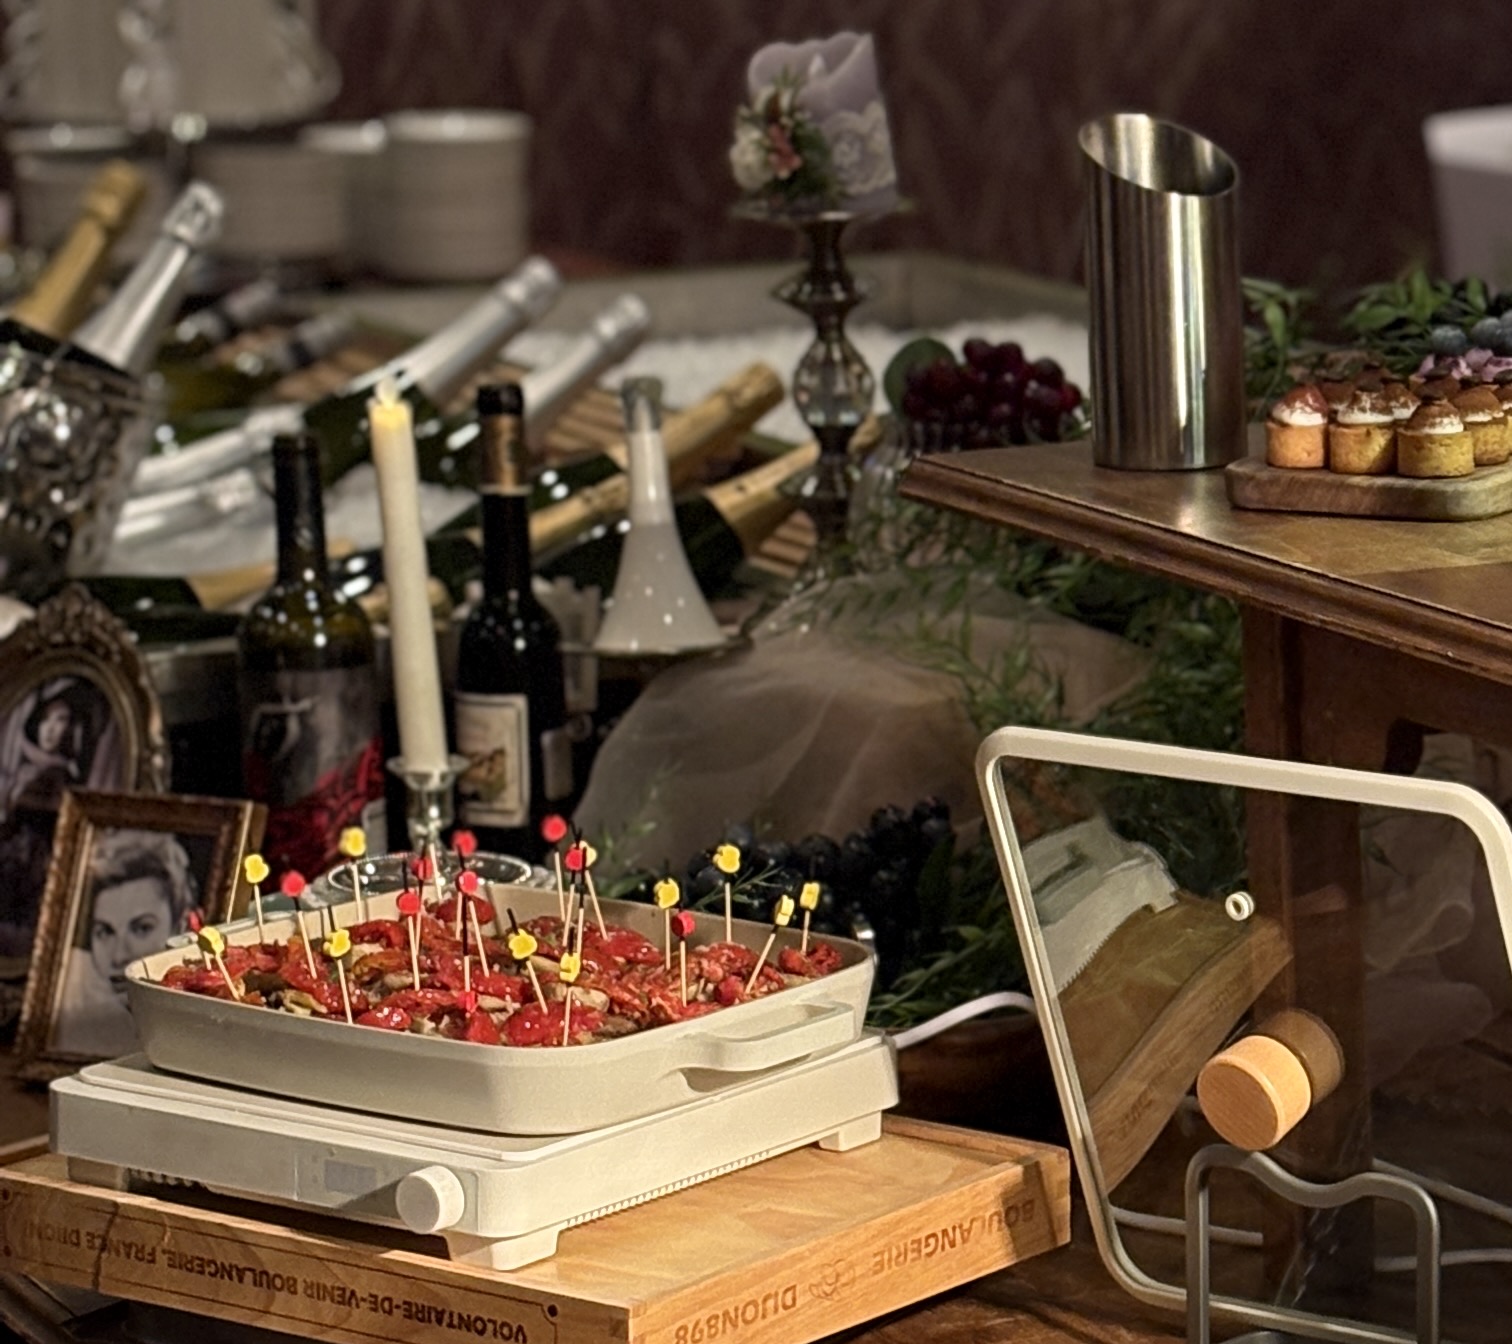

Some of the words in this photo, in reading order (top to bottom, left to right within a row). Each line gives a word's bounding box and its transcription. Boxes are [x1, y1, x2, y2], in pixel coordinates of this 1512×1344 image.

[86, 1230, 157, 1265] FRANCE
[872, 1198, 1036, 1277] BOULANGERIE
[303, 1278, 528, 1344] VOLONTAIRE-DE-VENIR
